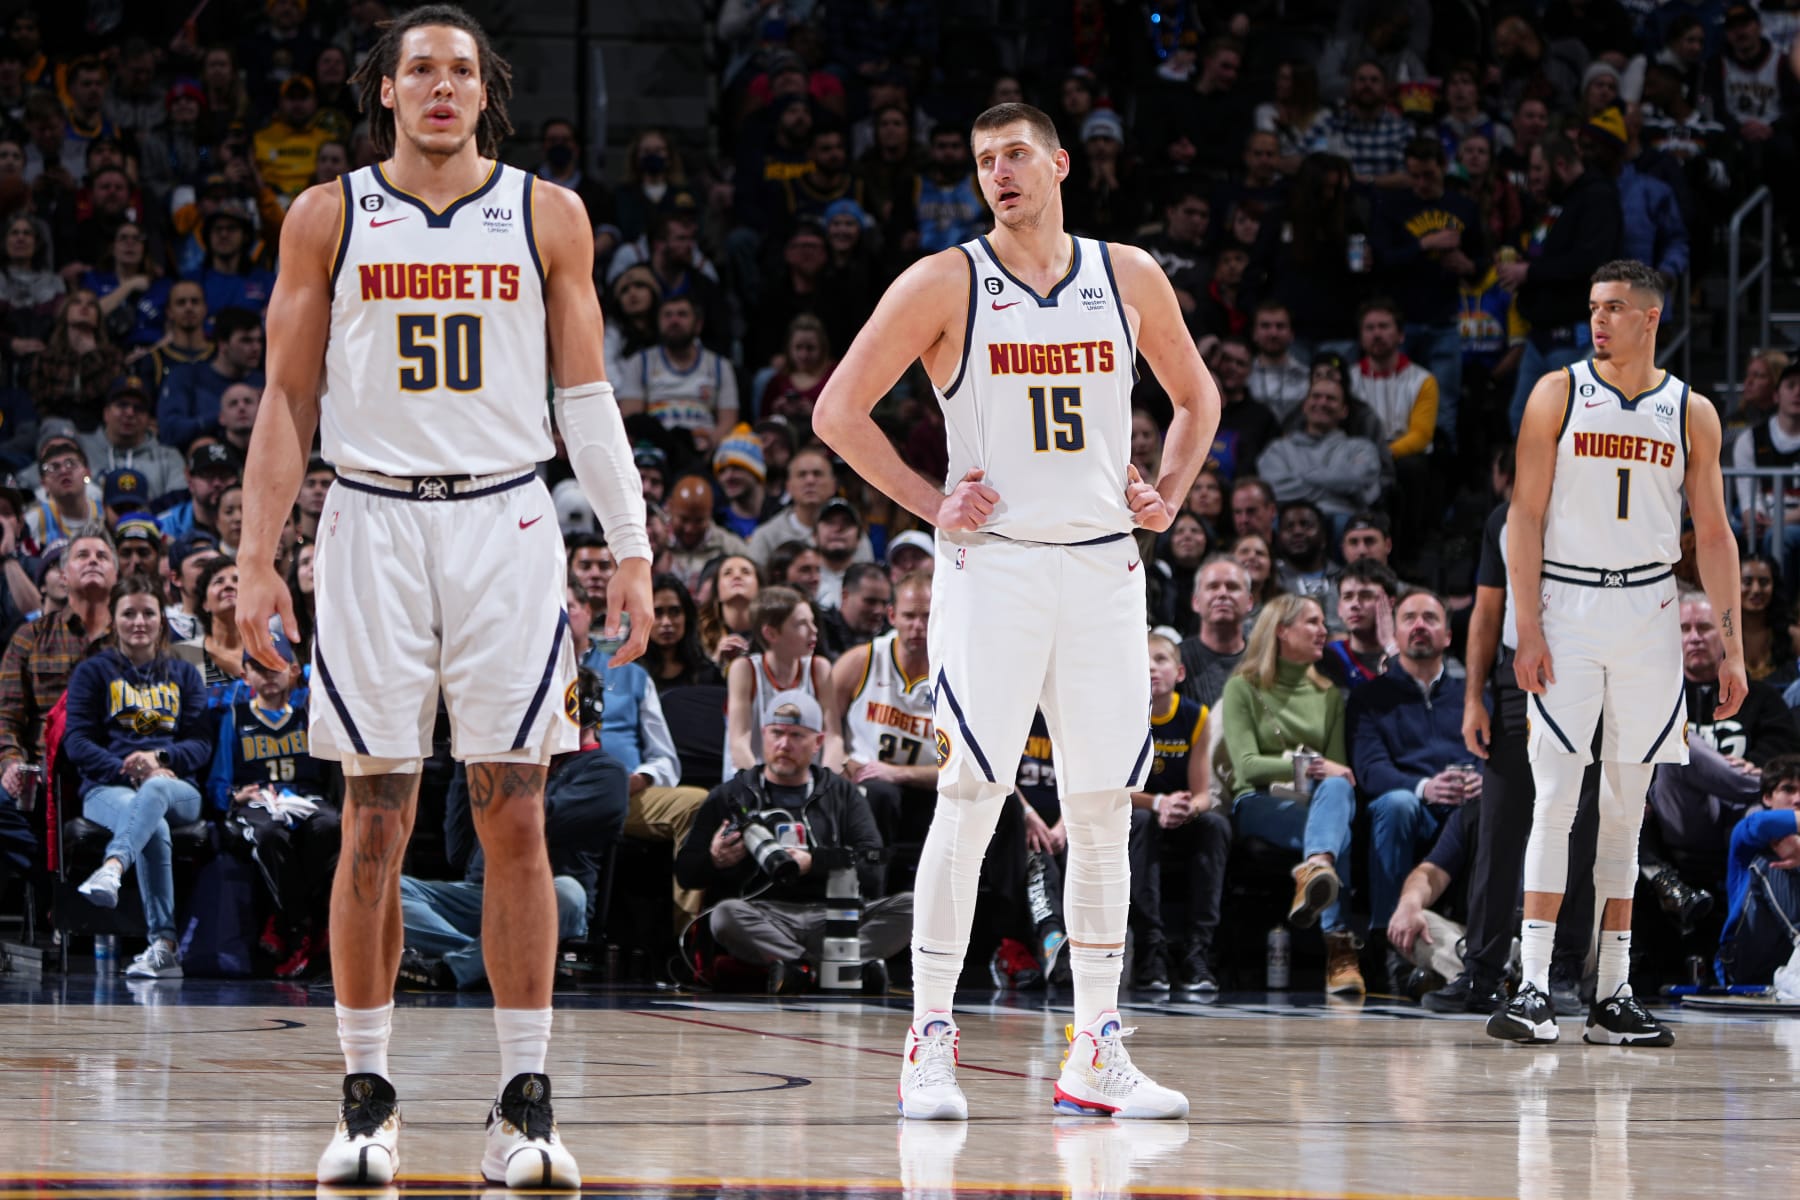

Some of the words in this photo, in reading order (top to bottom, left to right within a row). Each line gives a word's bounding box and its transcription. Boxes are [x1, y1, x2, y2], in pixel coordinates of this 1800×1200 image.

[482, 208, 512, 220] WU
[358, 263, 520, 301] NUGGETS
[1079, 288, 1103, 299] WU
[396, 313, 484, 394] 50
[988, 340, 1115, 375] NUGGETS
[1028, 386, 1086, 453] 15
[1573, 432, 1676, 468] NUGGETS
[1616, 468, 1631, 520] 1
[866, 701, 936, 740] NUGGET
[878, 733, 923, 766] 27
[265, 758, 296, 782] 15
